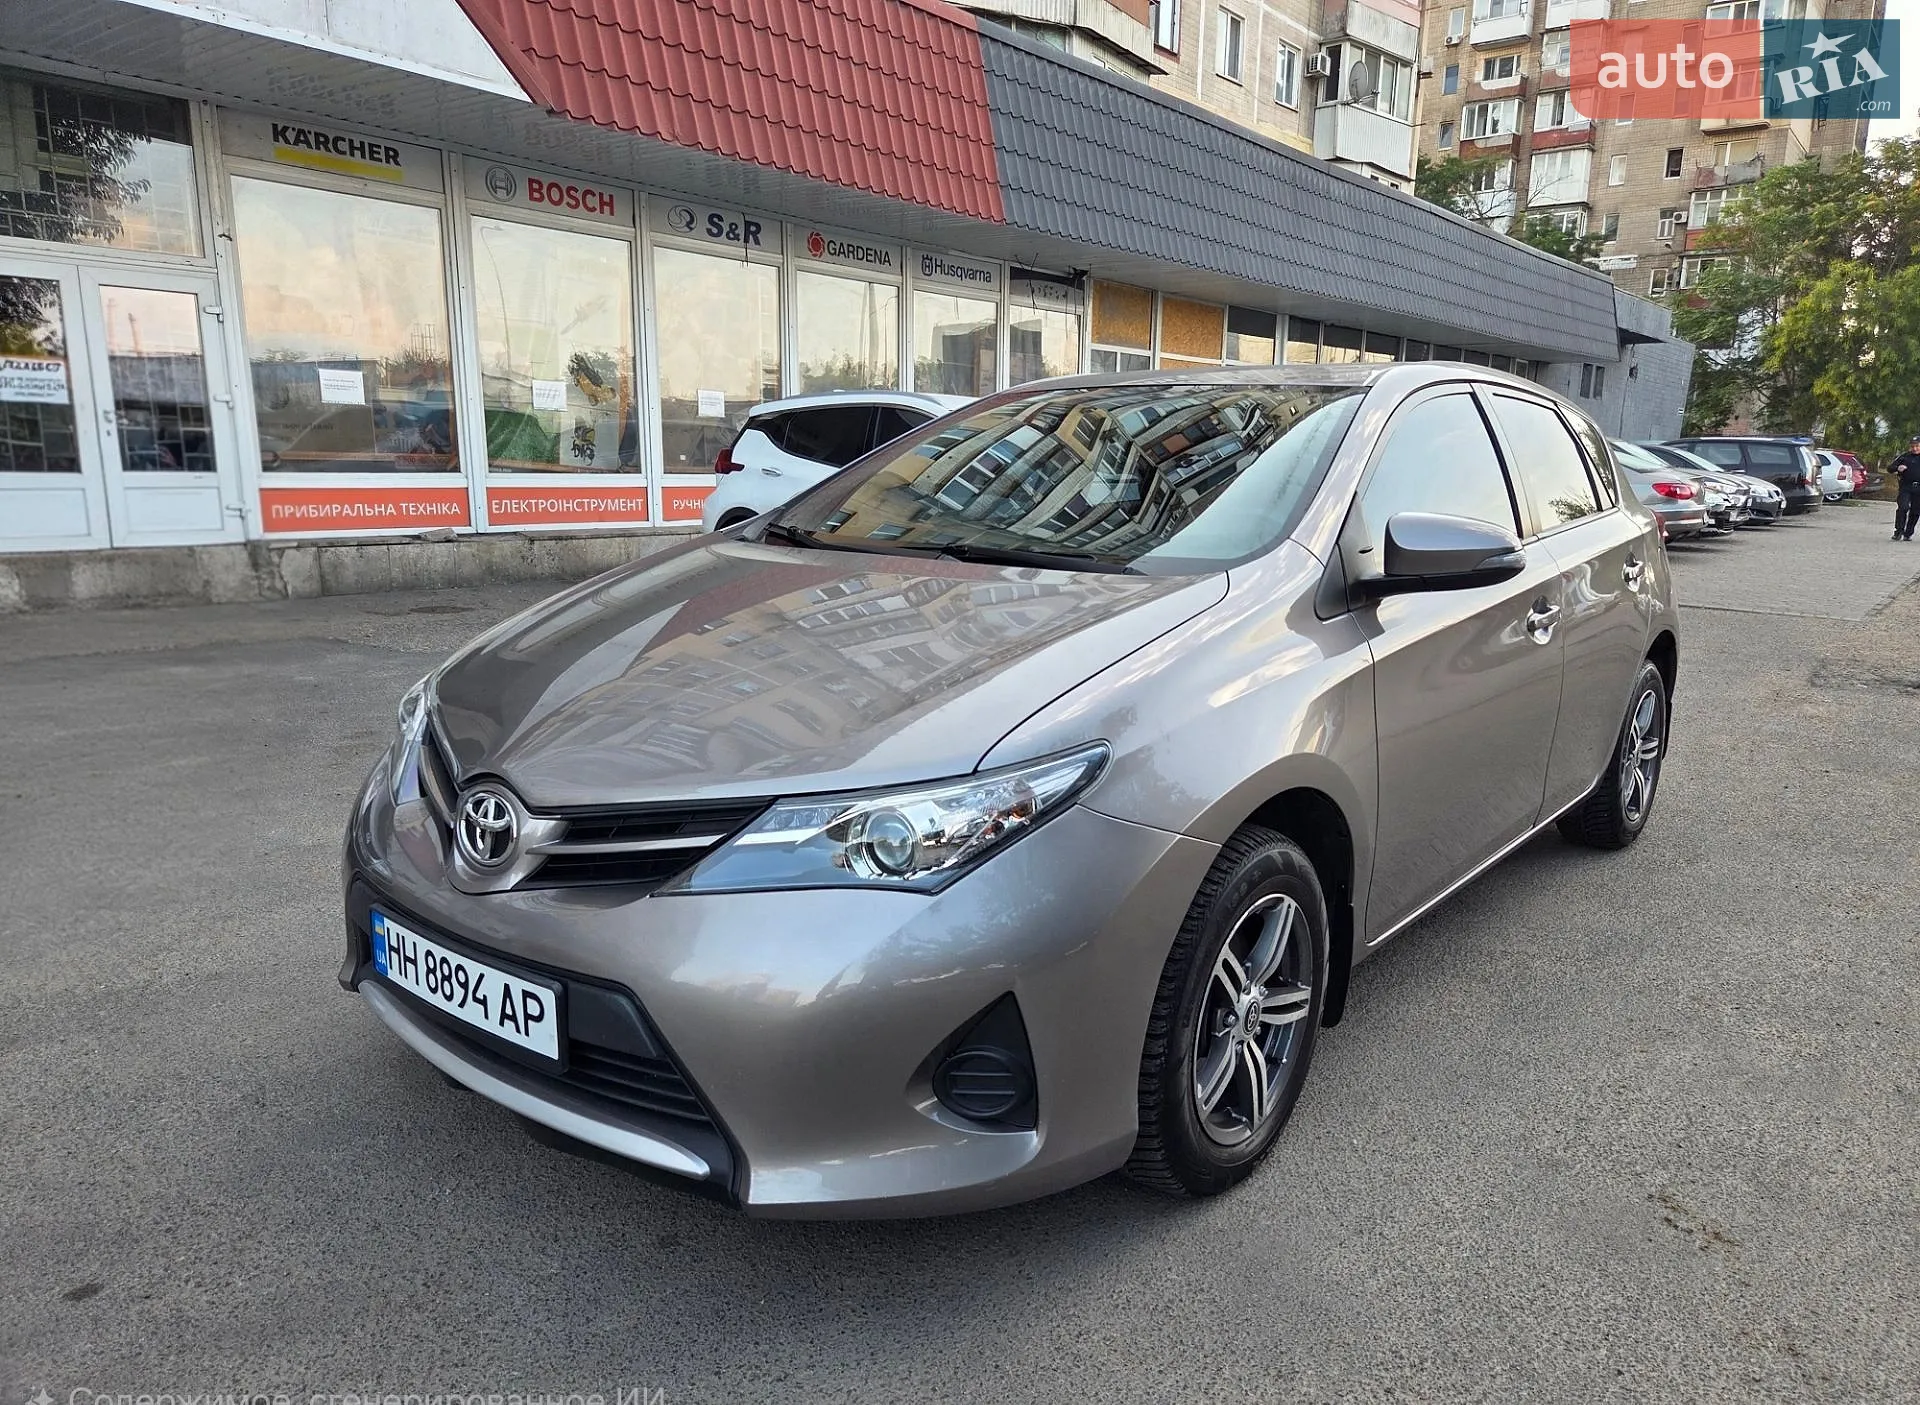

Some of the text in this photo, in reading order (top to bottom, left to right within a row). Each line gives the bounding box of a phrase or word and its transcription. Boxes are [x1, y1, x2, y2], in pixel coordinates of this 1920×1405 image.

[271, 122, 402, 167] KÄRCHER
[527, 177, 615, 216] BOSCH
[705, 212, 762, 247] S&R
[826, 239, 892, 267] GARDENA
[934, 257, 992, 283] Husqvarna
[271, 502, 461, 519] ПРИБИРАЛЬНА ТЕХНІКА
[491, 498, 644, 514] ЕЛЕКТРОІНСТРУМЕНТ
[377, 949, 387, 965] UA
[386, 927, 545, 1037] HH 8894 AP
